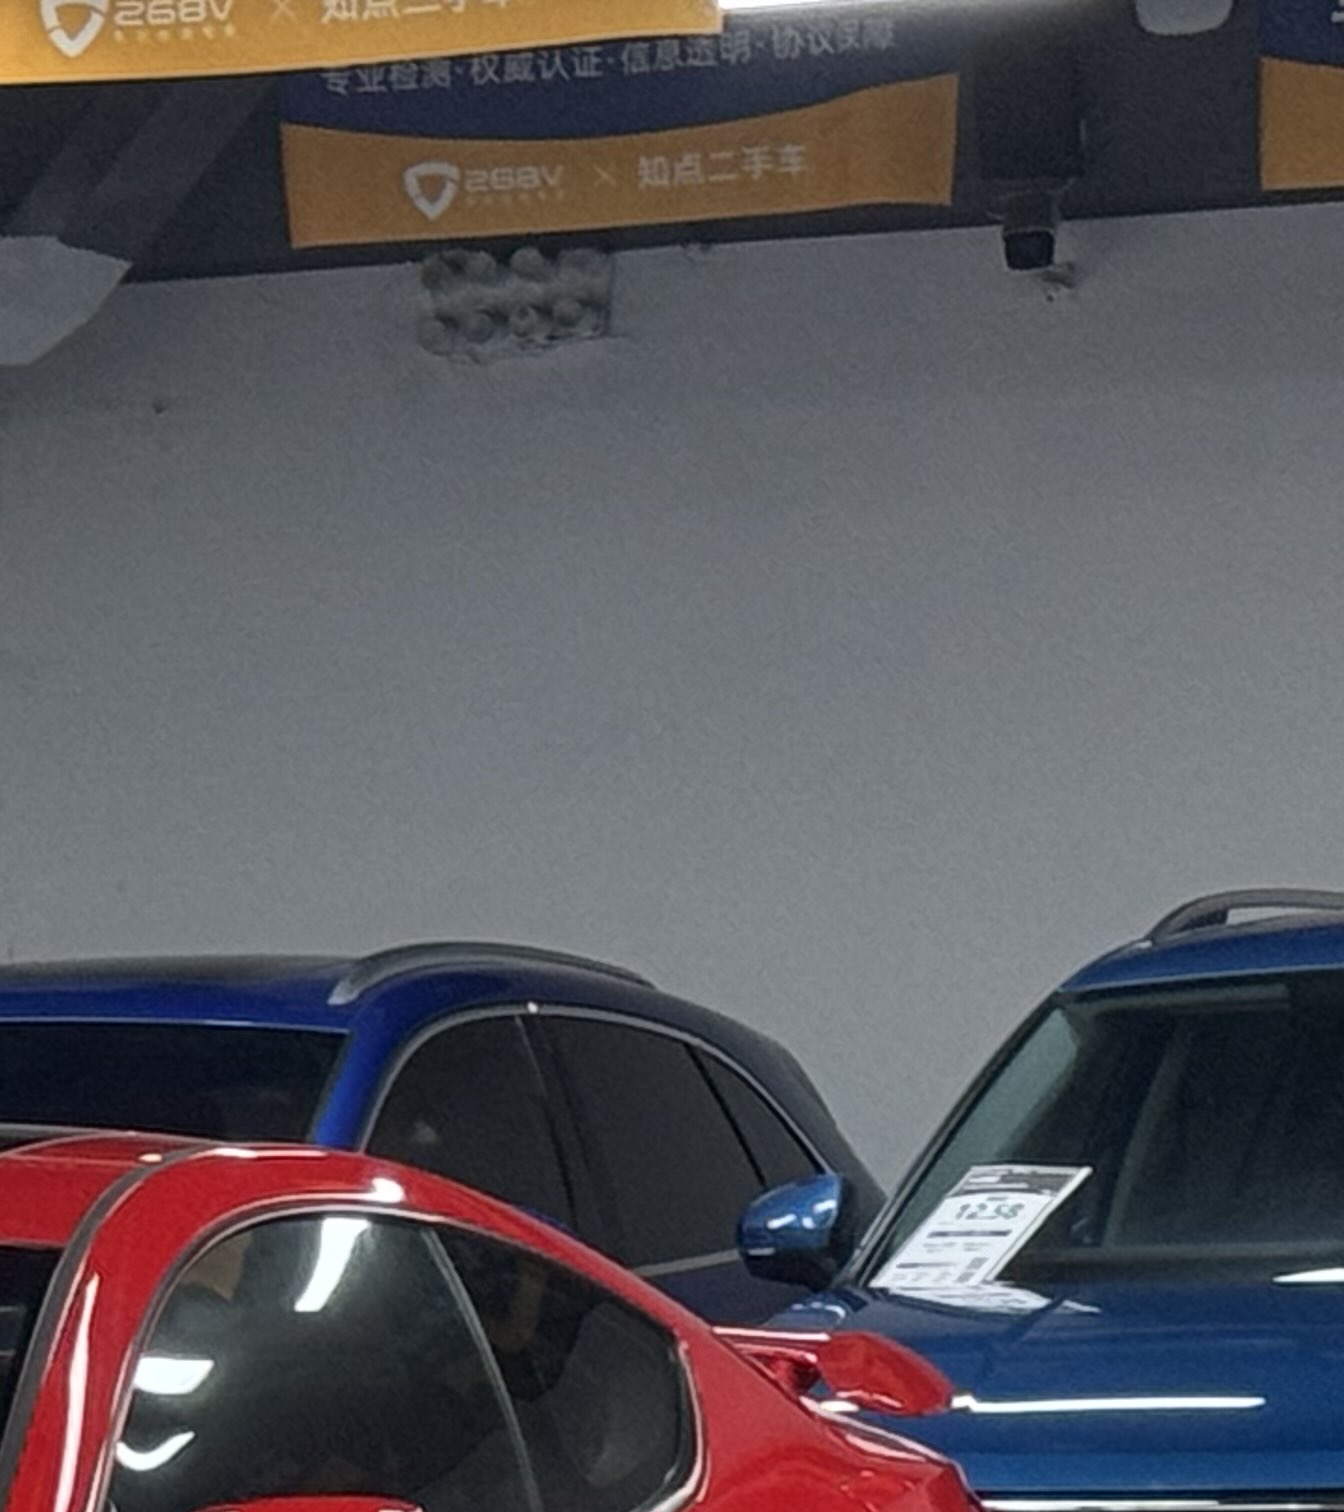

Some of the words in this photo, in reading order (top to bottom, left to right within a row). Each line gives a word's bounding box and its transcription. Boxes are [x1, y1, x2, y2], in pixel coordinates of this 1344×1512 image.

[637, 143, 809, 189] 知点二手车
